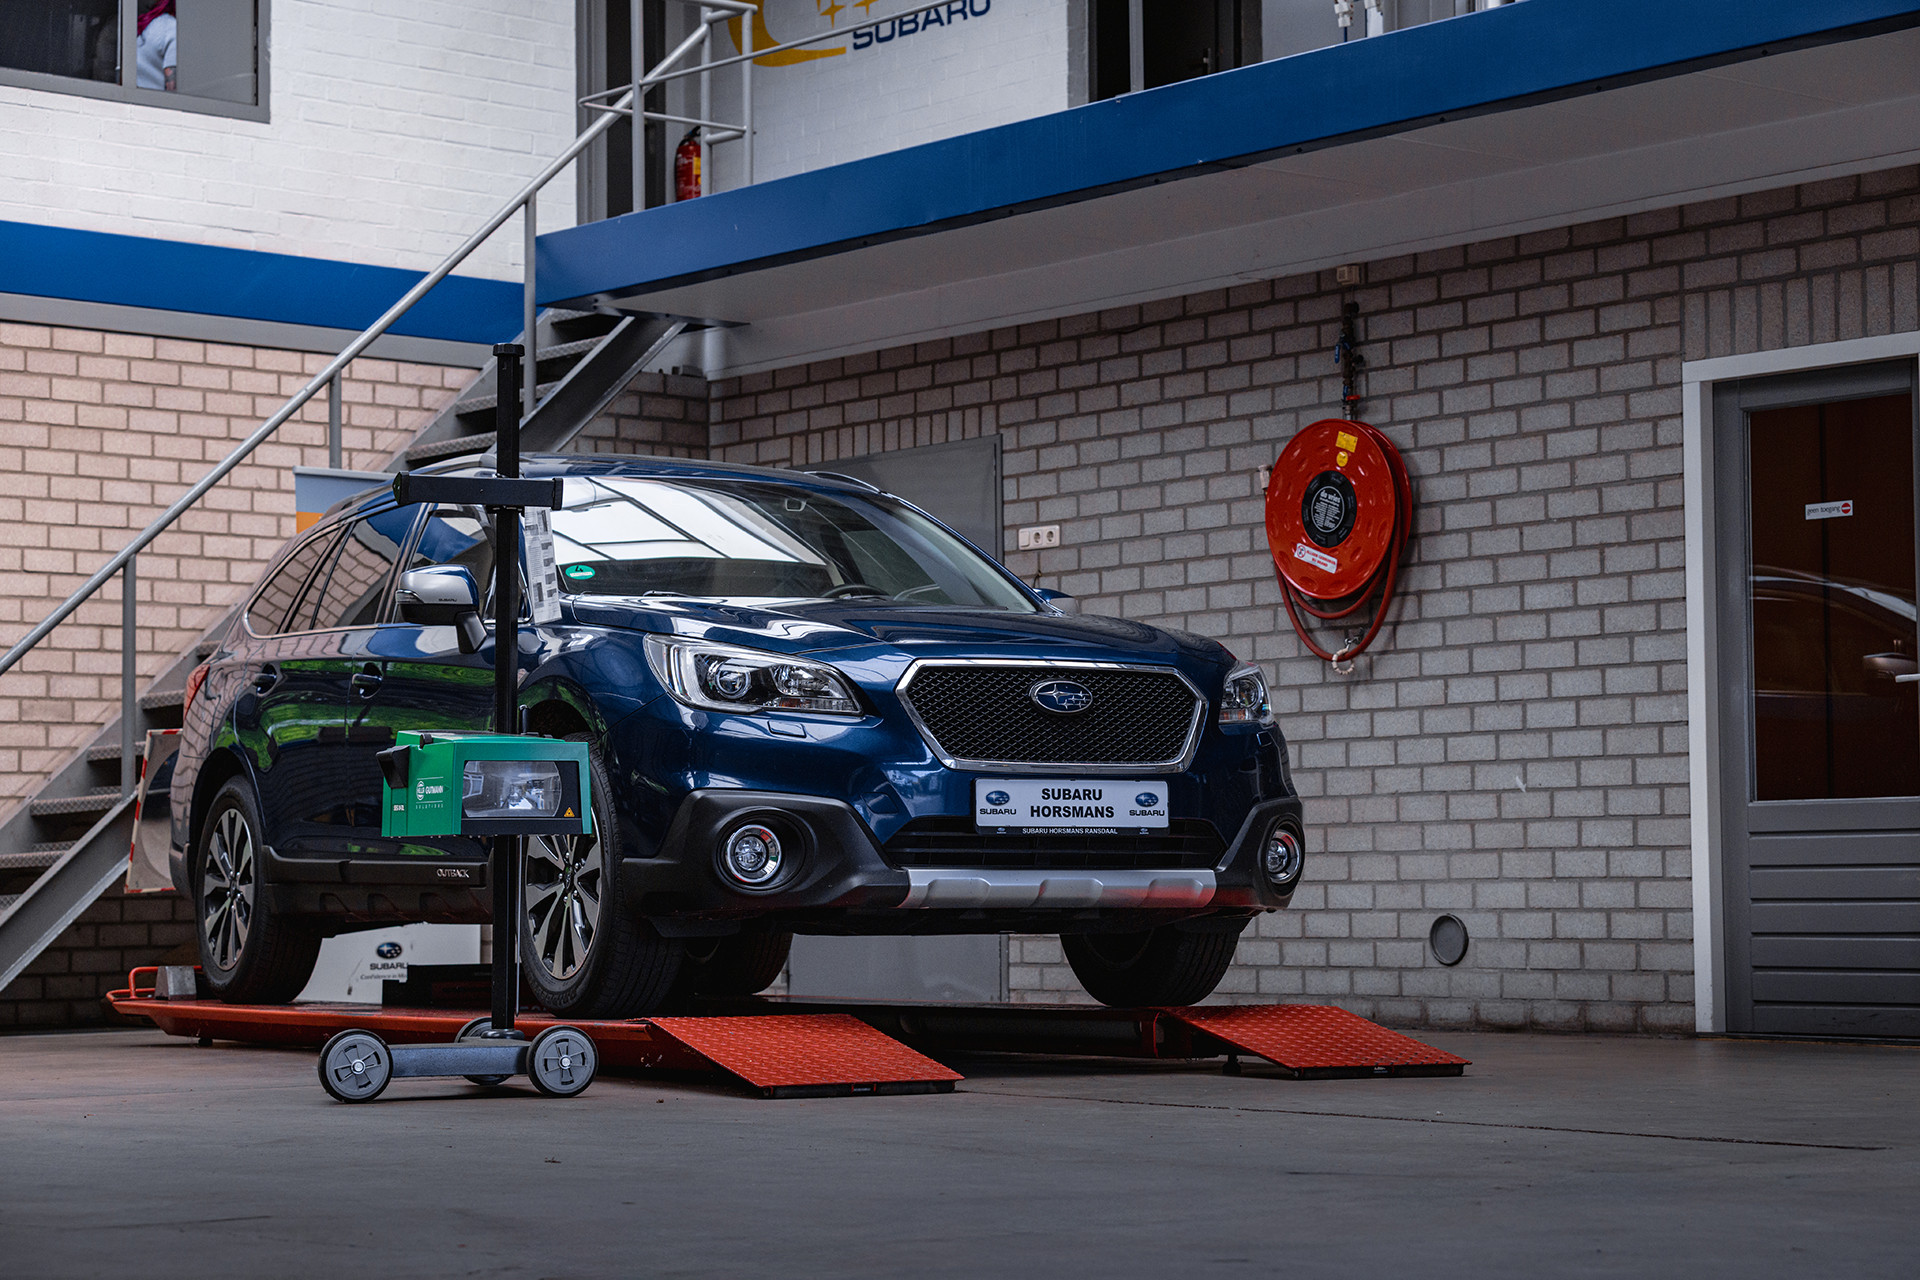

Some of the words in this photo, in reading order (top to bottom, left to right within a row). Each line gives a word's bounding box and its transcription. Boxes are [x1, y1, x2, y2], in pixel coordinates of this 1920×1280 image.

[852, 0, 991, 50] SUBARU
[1041, 788, 1103, 801] SUBARU
[1030, 805, 1115, 819] HORSMANS
[1022, 827, 1048, 835] SUBARU
[1049, 827, 1084, 835] HORSMANS
[436, 868, 470, 878] OUTBACK
